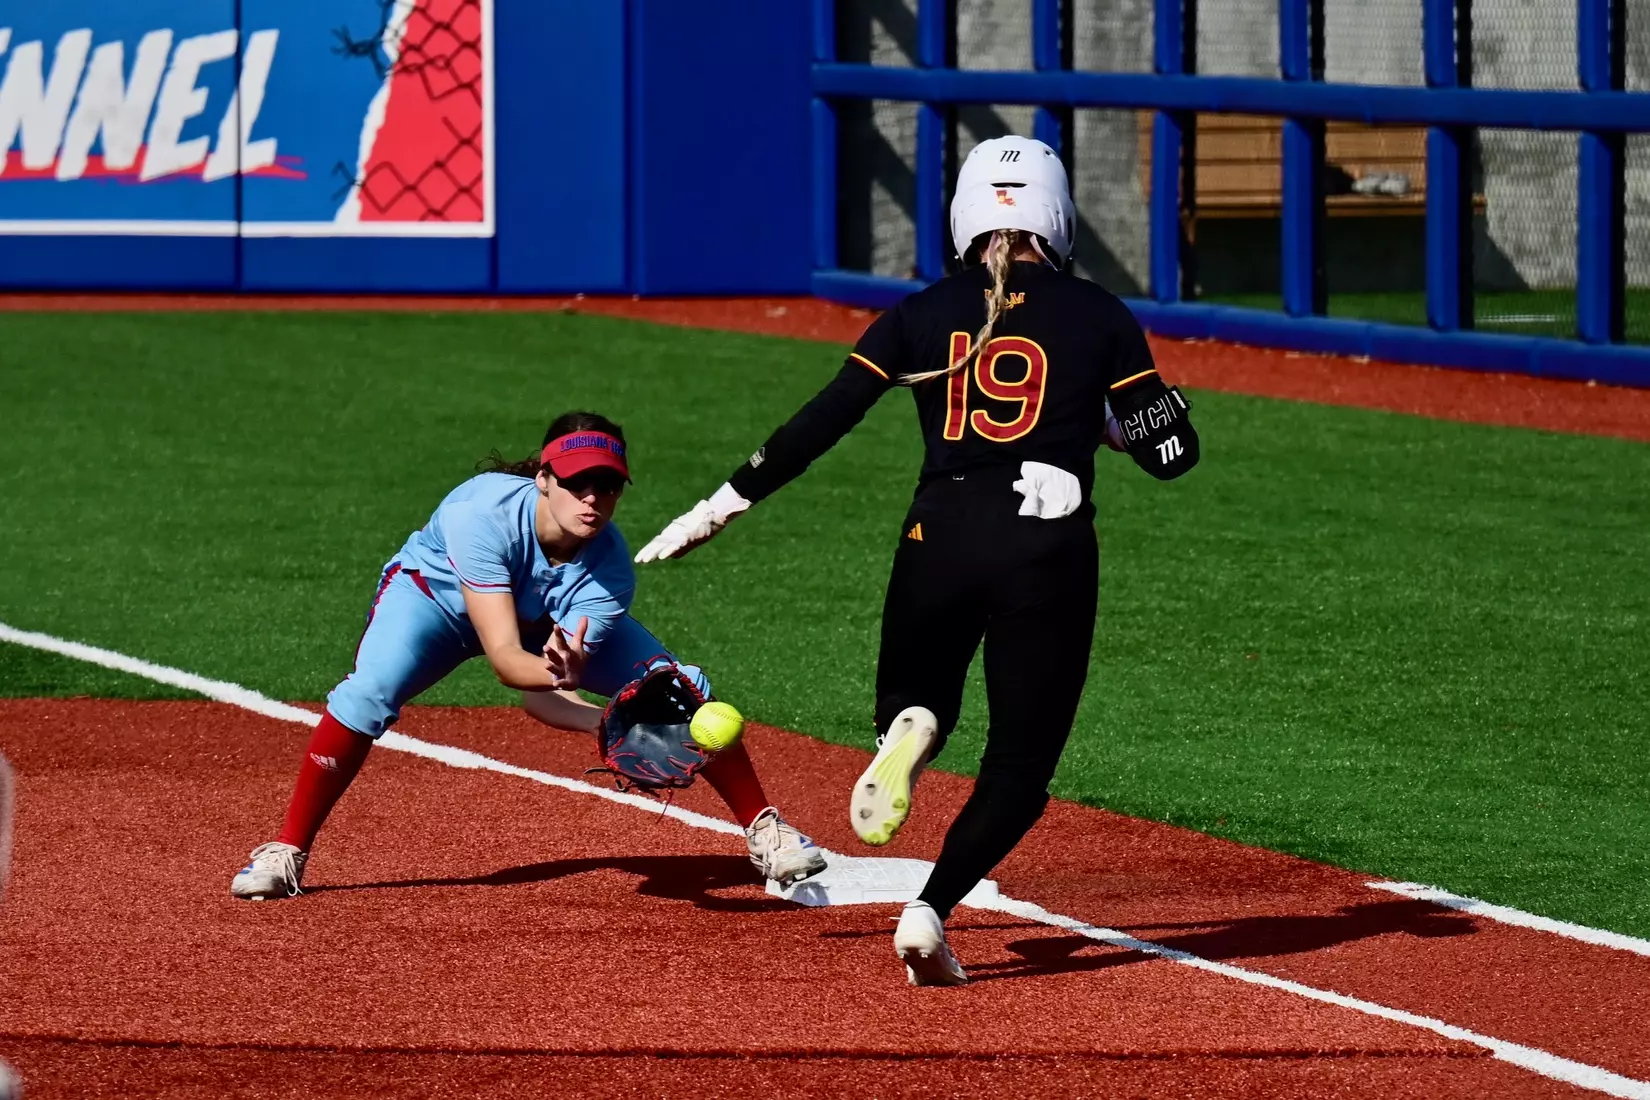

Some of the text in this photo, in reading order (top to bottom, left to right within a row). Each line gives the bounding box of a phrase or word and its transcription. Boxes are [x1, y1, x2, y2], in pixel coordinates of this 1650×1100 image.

[0, 27, 279, 182] NNEL
[943, 332, 1048, 442] 19
[561, 435, 608, 452] LOUISIANA
